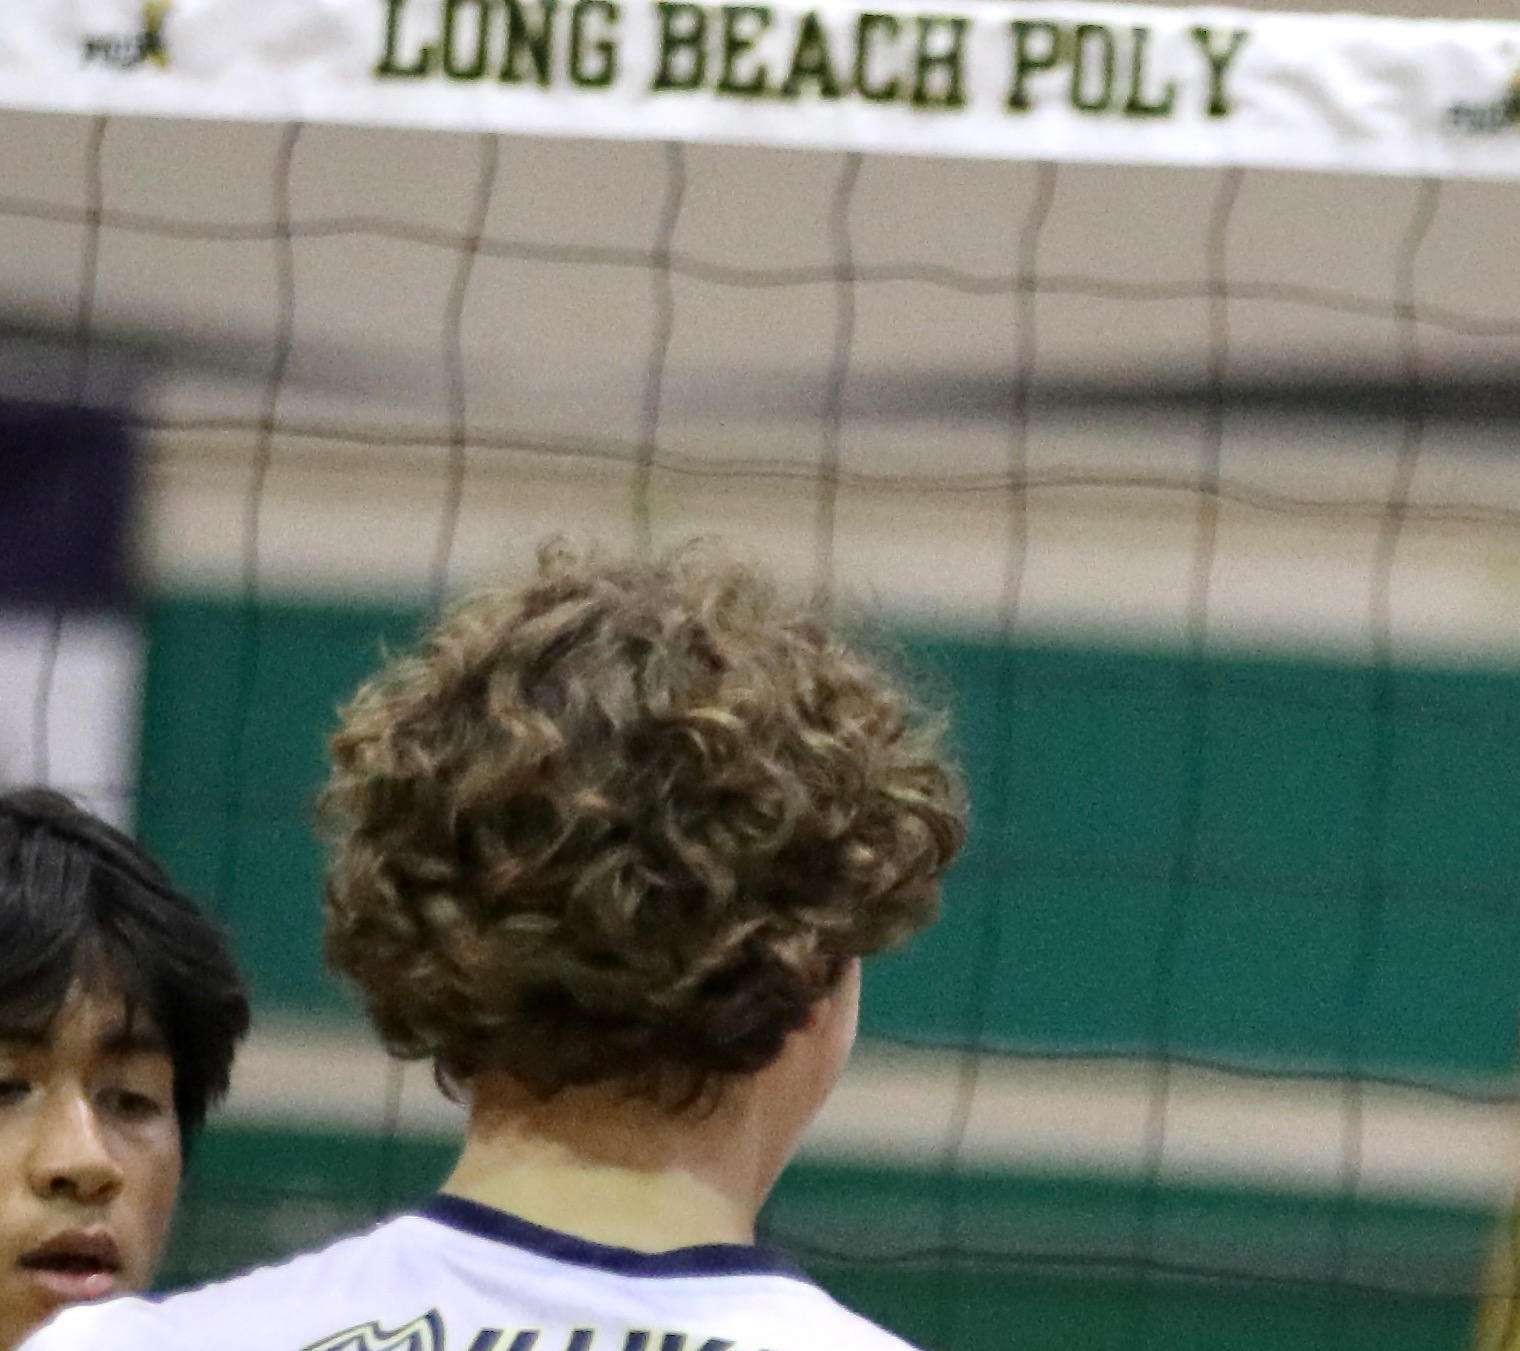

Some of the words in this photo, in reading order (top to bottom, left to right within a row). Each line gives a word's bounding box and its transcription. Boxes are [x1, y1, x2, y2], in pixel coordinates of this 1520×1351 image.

[373, 0, 618, 92] LONG
[650, 2, 972, 107] BEACH
[1004, 18, 1250, 119] POLY
